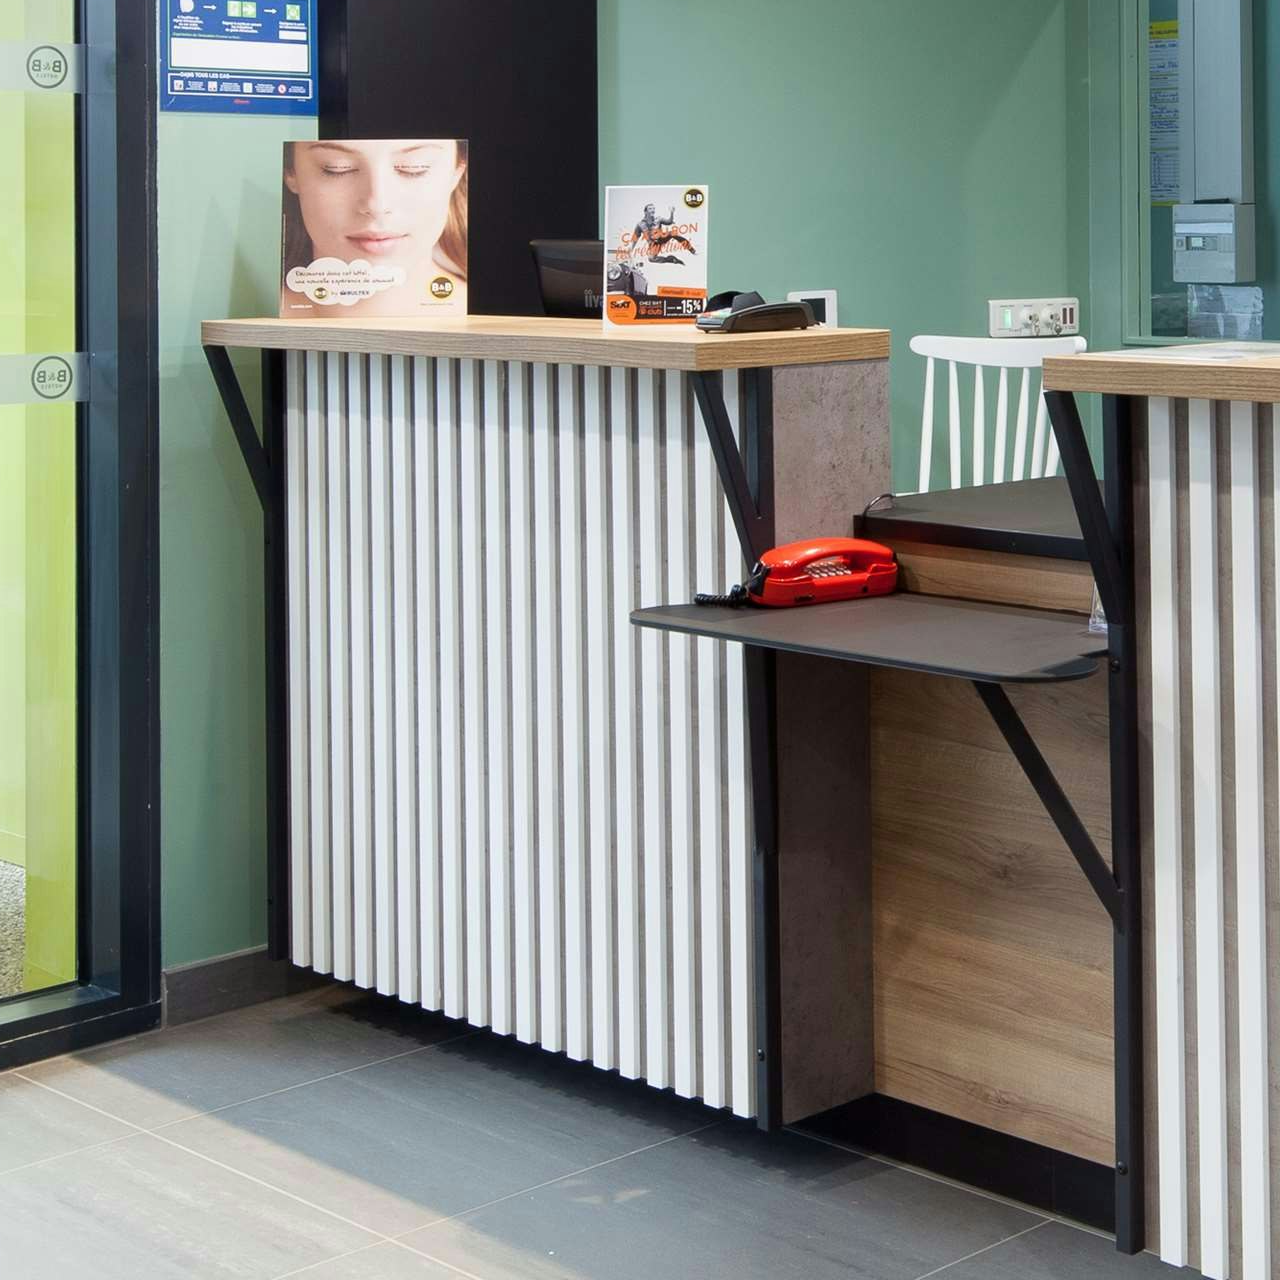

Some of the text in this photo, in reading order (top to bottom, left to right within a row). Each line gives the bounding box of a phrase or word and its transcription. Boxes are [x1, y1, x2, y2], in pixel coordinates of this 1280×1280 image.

[685, 193, 703, 202] B&B
[671, 222, 698, 236] BON
[432, 282, 452, 292] B&B
